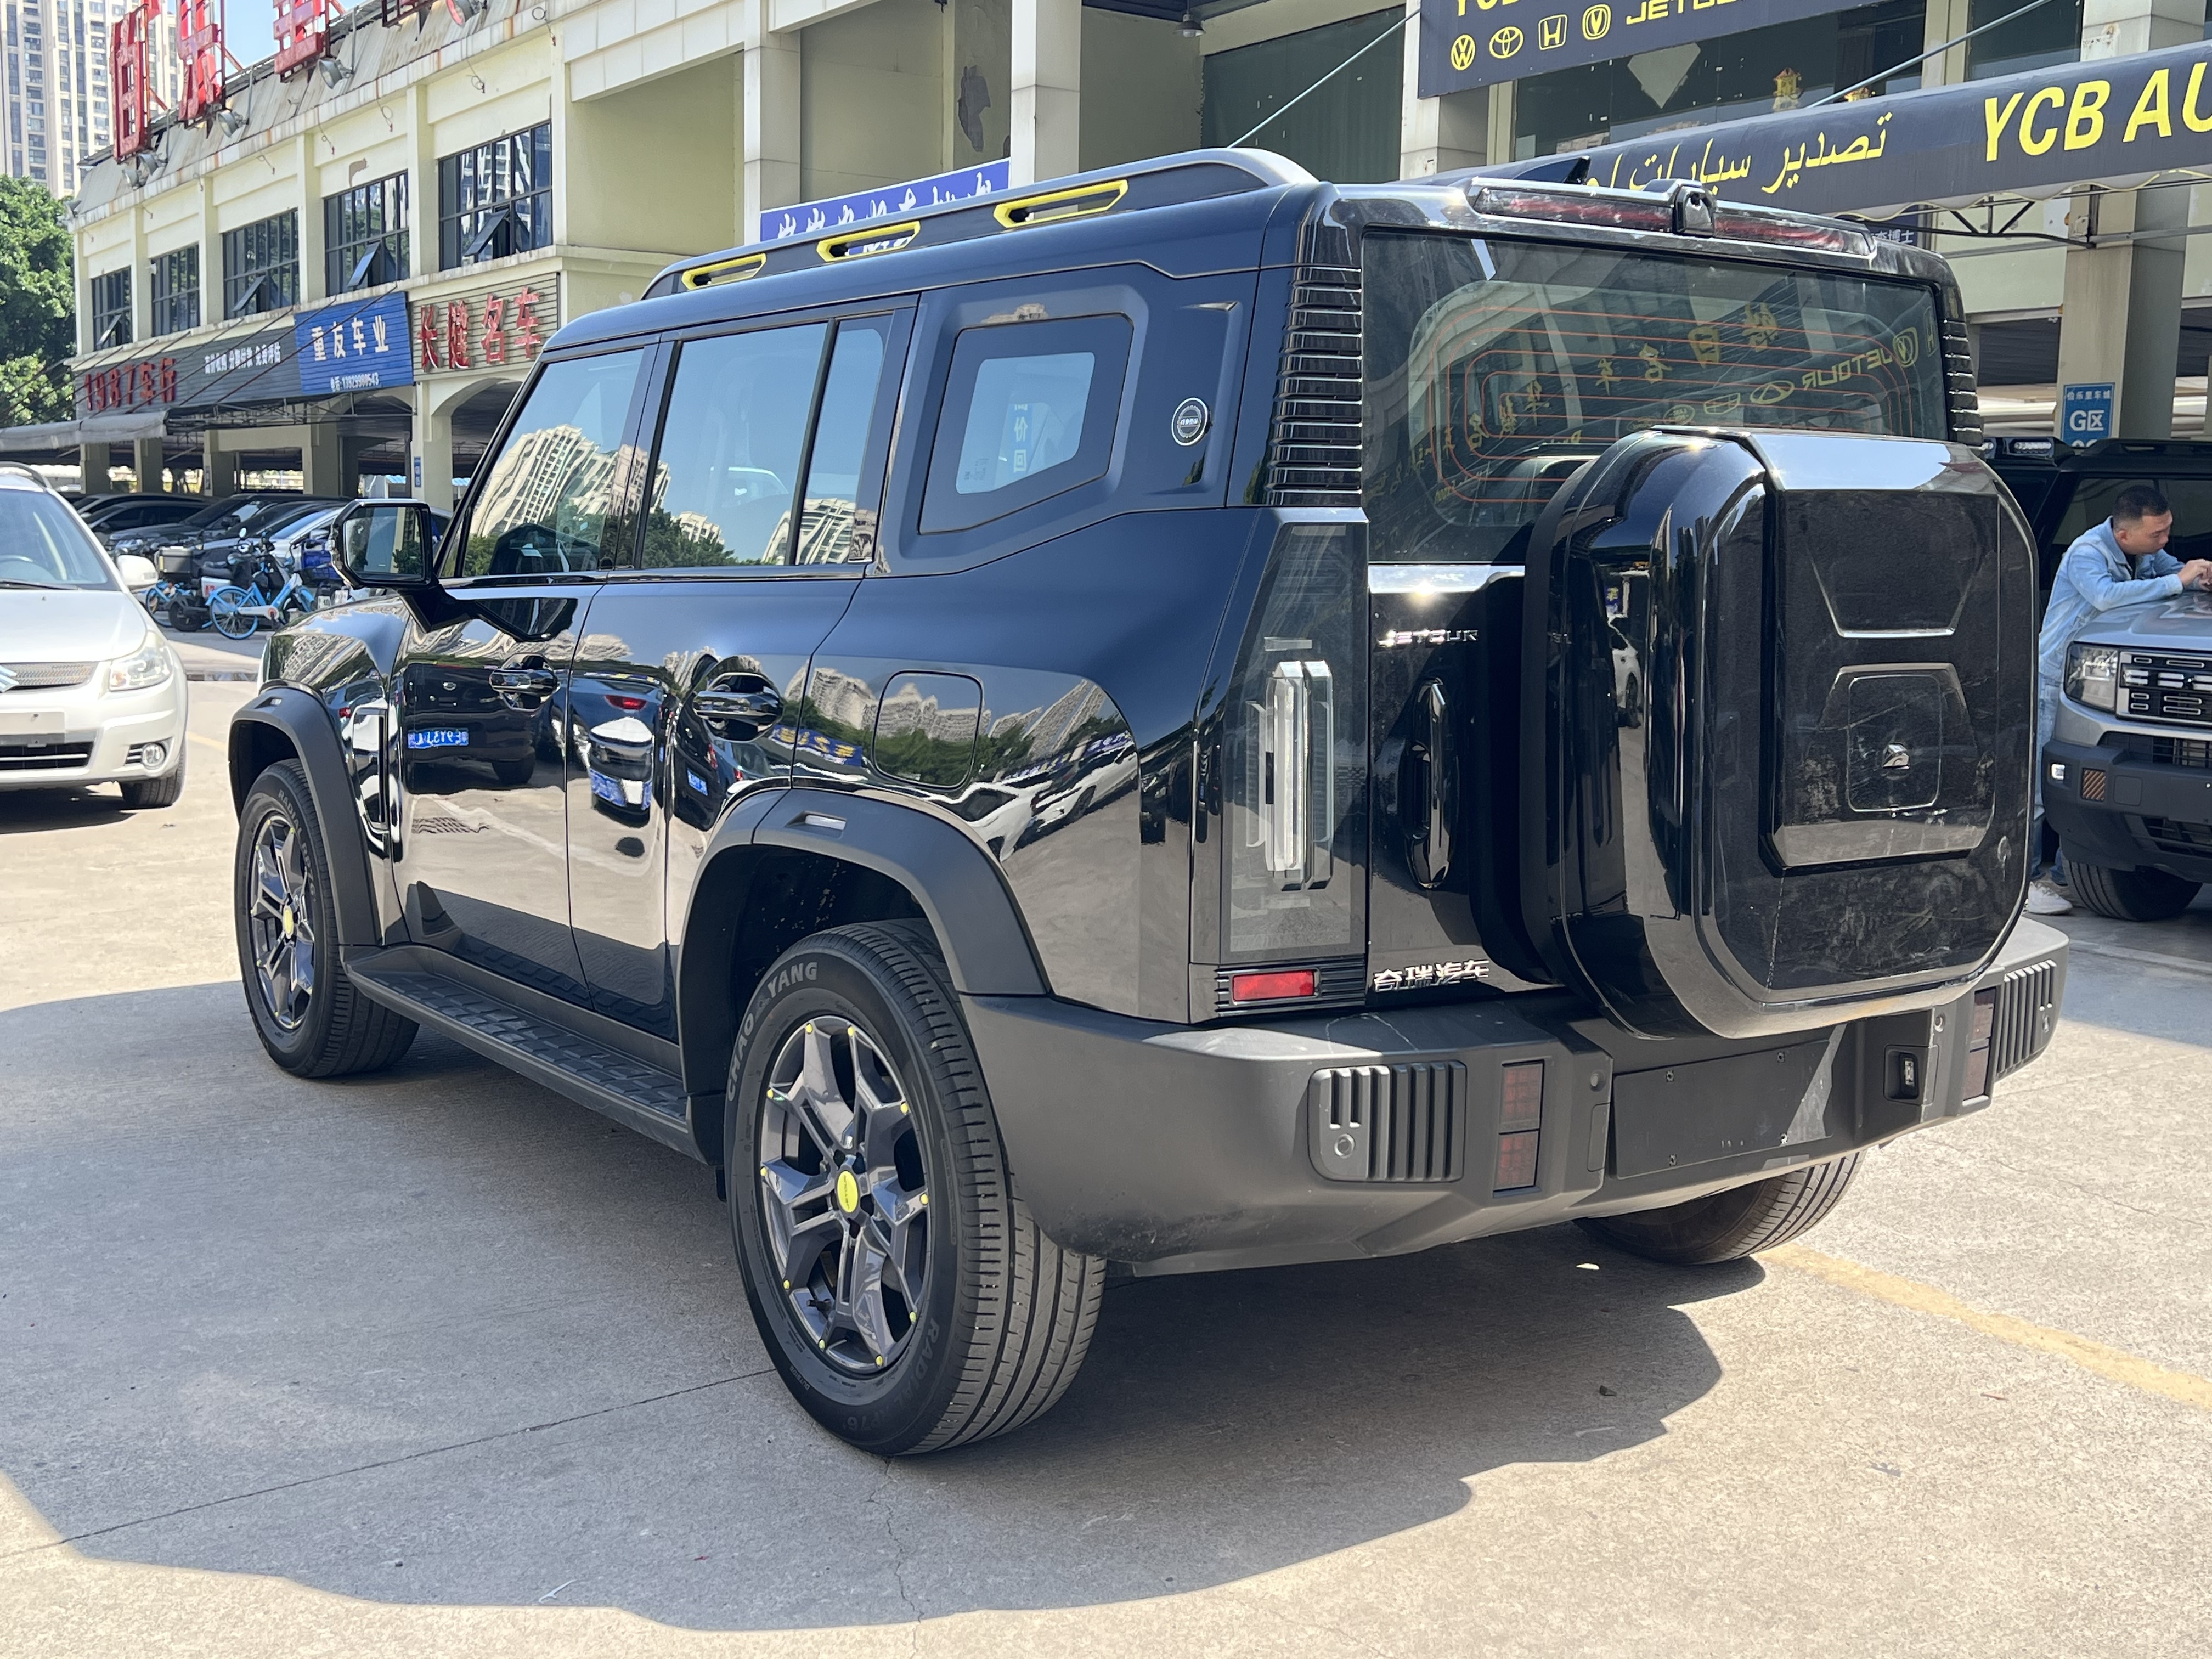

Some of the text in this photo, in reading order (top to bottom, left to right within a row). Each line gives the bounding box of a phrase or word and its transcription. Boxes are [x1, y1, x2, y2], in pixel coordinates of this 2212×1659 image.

[1761, 112, 1893, 194] تصدير
[1983, 80, 2112, 162] YCB
[311, 315, 389, 361] 重友车业
[2069, 409, 2105, 431] G区
[1373, 959, 1491, 994] 奇瑞汽车
[727, 961, 818, 1102] CHAO YANG
